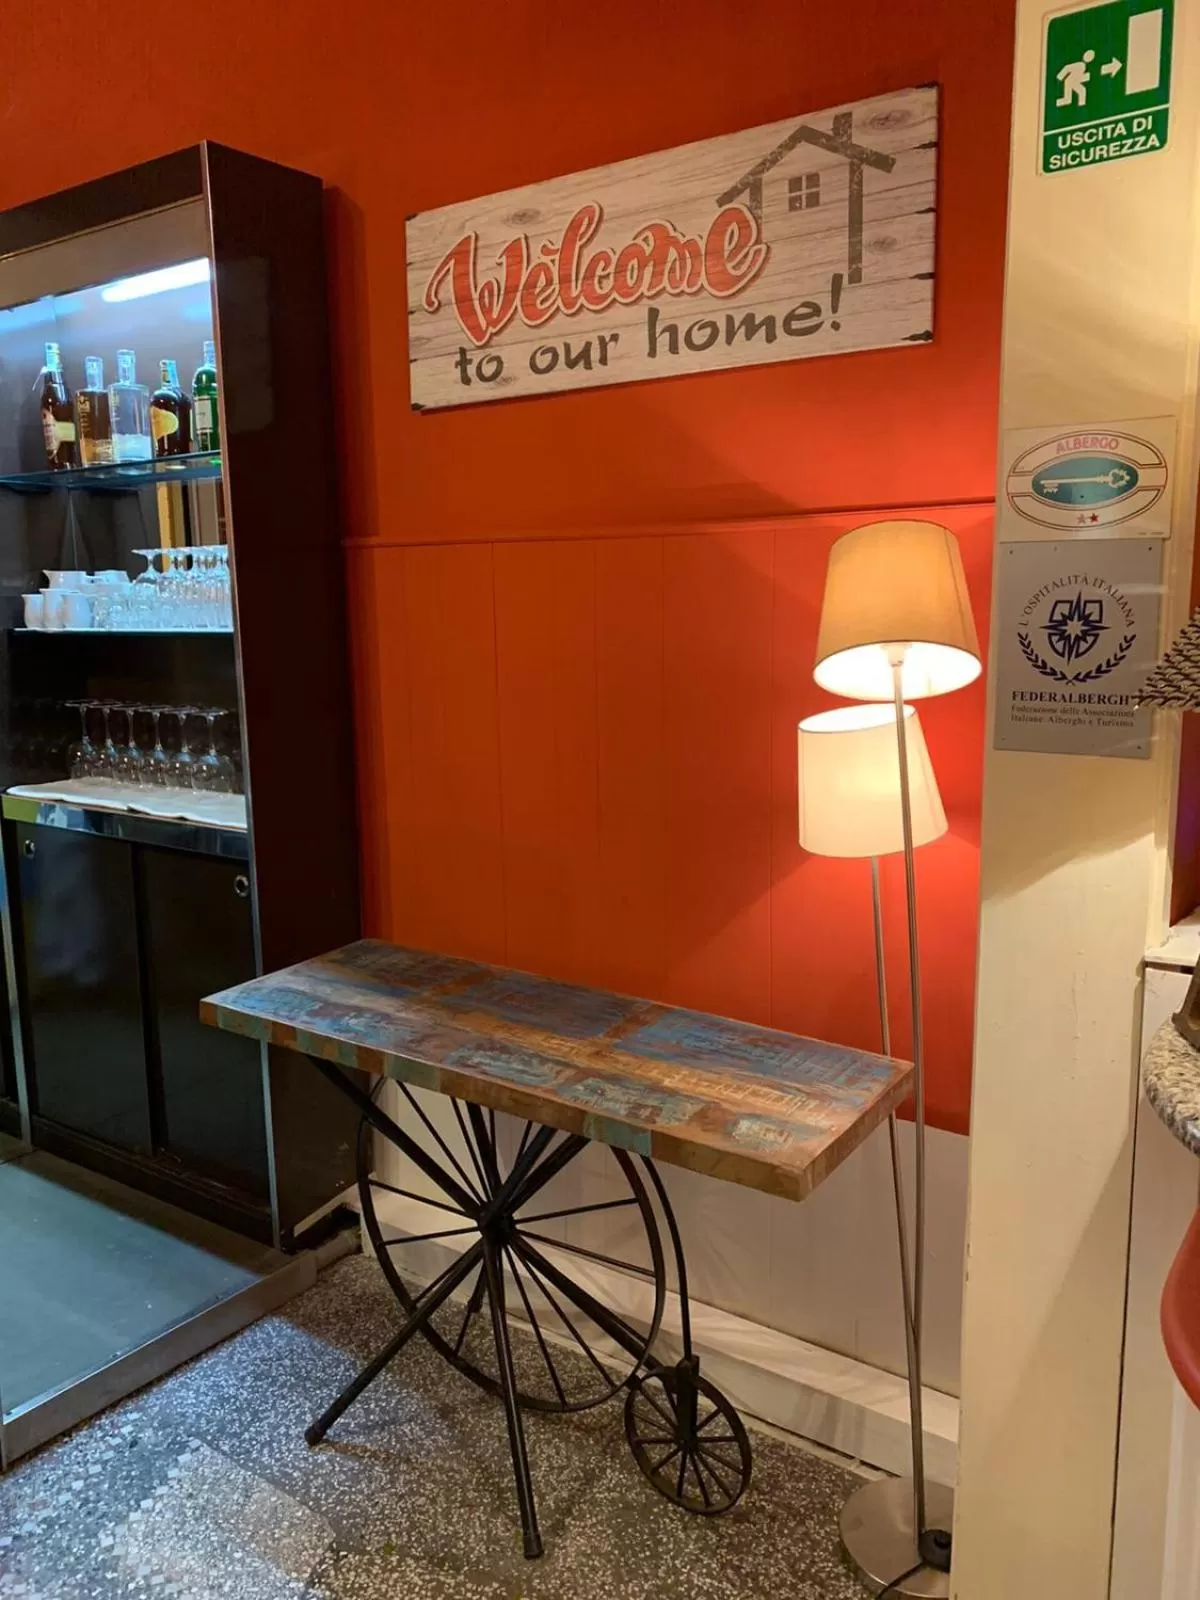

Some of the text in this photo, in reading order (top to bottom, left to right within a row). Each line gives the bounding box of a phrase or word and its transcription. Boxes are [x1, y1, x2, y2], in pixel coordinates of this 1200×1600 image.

[1057, 115, 1153, 149] USCITA DI
[1049, 133, 1161, 170] SICUREZZA
[424, 200, 771, 349] Welcome
[455, 272, 844, 387] to our home!
[1055, 435, 1120, 455] ALBERGO
[1092, 576, 1136, 629] ITALIANA
[1011, 690, 1131, 706] FEDERALBERGH
